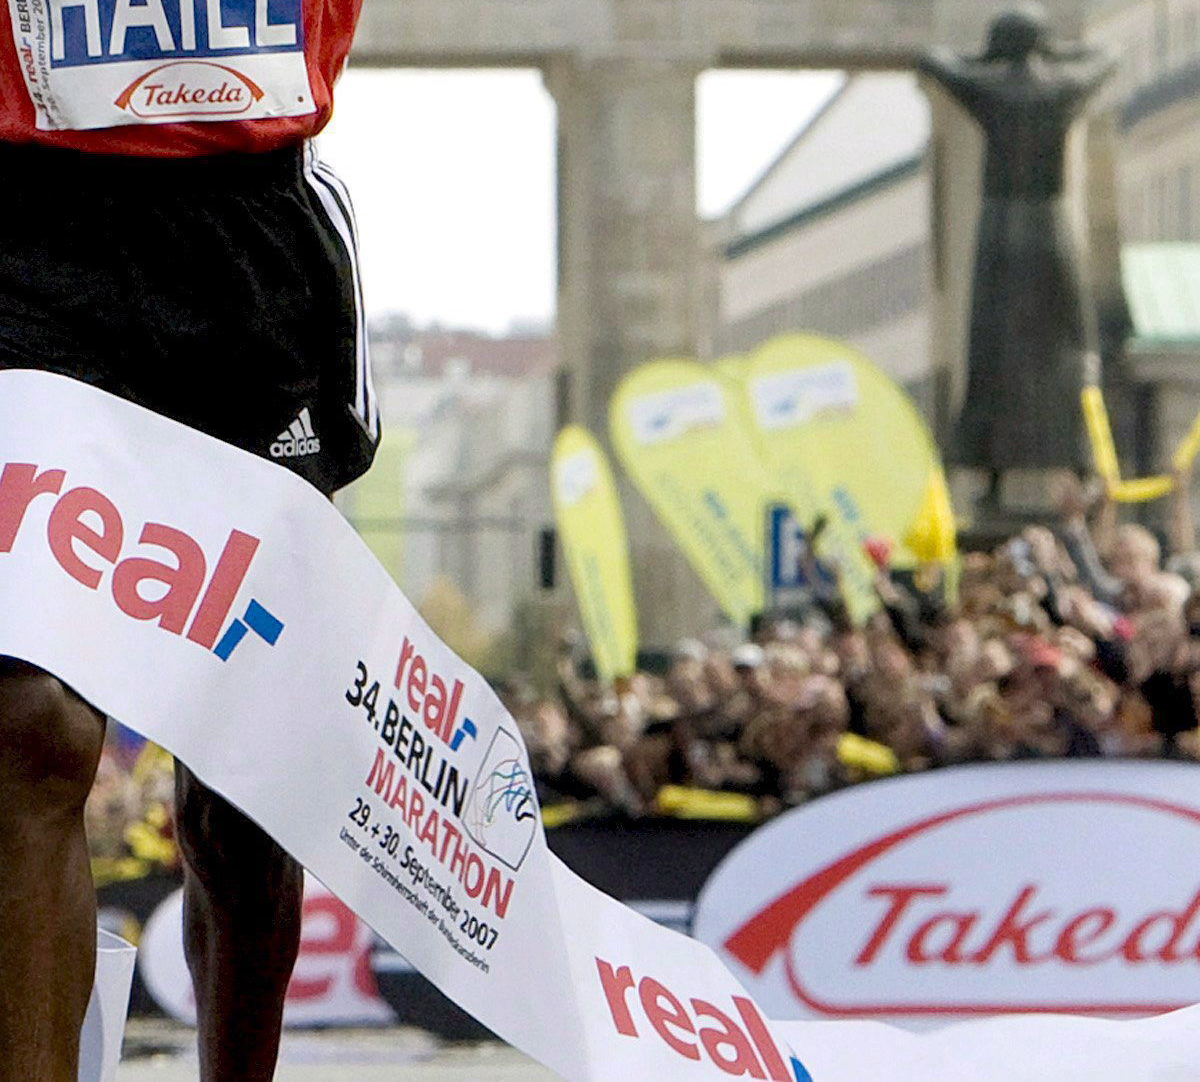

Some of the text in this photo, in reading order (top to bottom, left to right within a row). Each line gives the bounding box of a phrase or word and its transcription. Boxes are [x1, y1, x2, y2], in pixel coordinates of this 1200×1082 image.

[143, 83, 244, 107] Takeda
[270, 437, 321, 458] adidas
[380, 698, 469, 818] BERLIN
[348, 798, 369, 832] 29.
[379, 825, 398, 860] 30.
[400, 845, 460, 921] September
[459, 909, 499, 951] 2007
[365, 747, 515, 919] MARATHON
[853, 881, 1200, 965] Taked
[594, 956, 796, 1082] real
